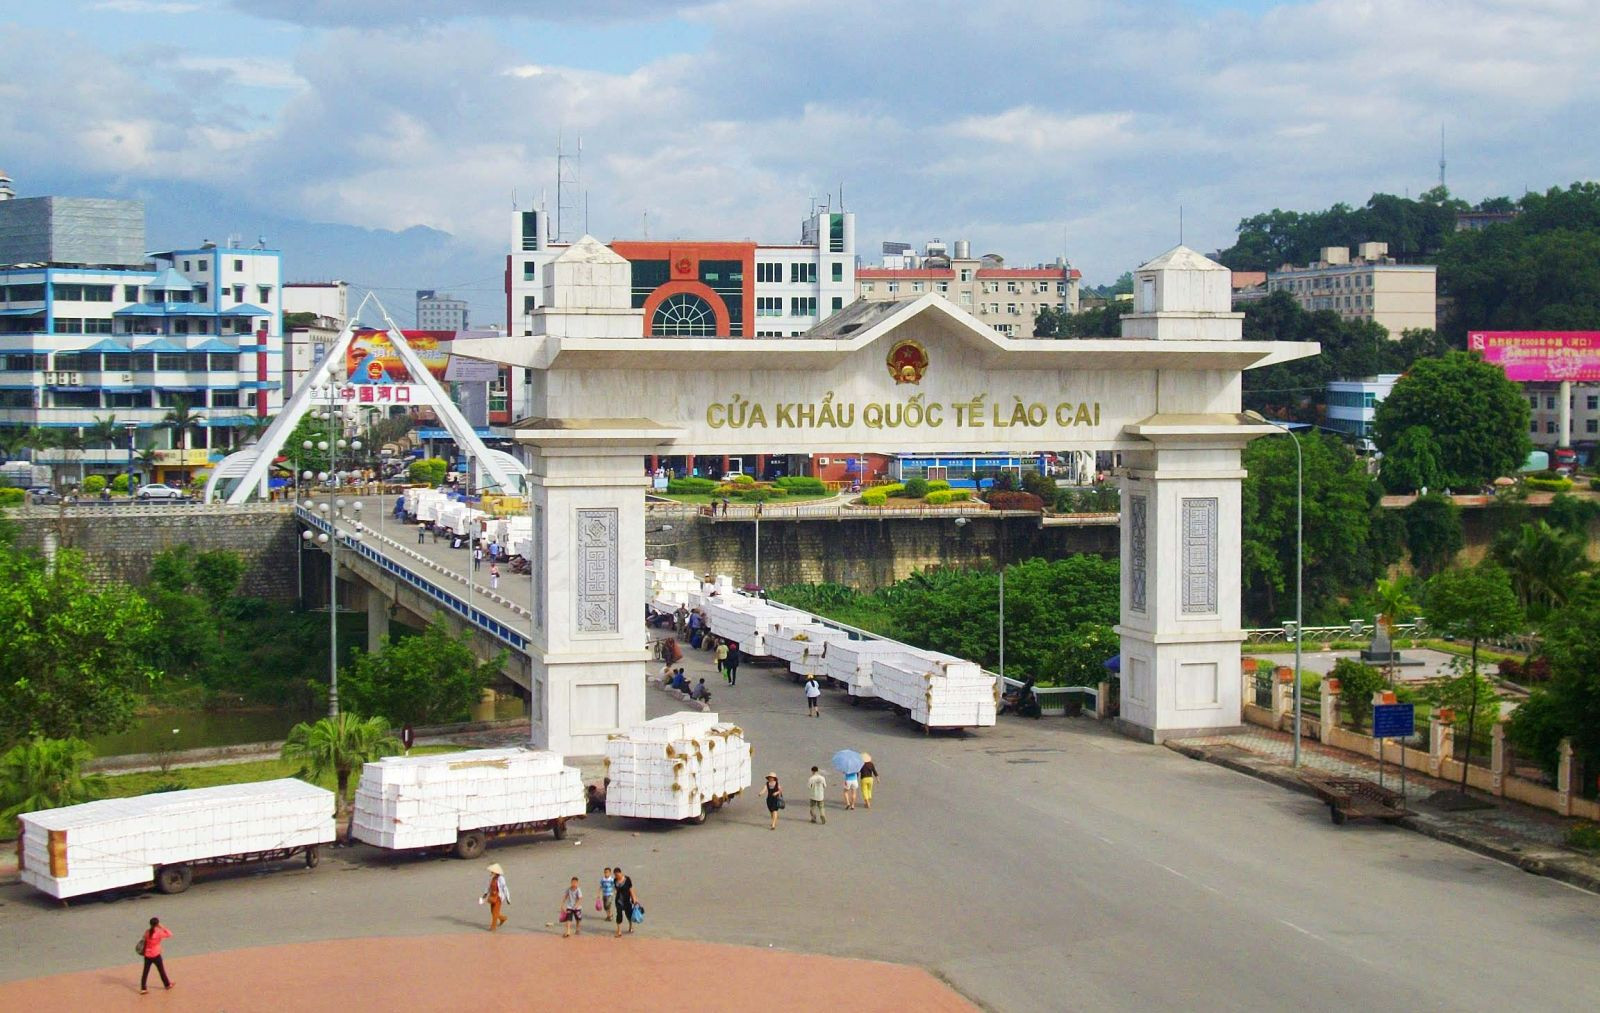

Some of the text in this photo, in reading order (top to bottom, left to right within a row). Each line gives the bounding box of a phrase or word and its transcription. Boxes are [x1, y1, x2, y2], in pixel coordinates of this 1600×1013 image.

[340, 386, 410, 403] 中国河口
[706, 391, 1100, 430] CỬA KHẨU QUỐC TẾ LÀO CAI
